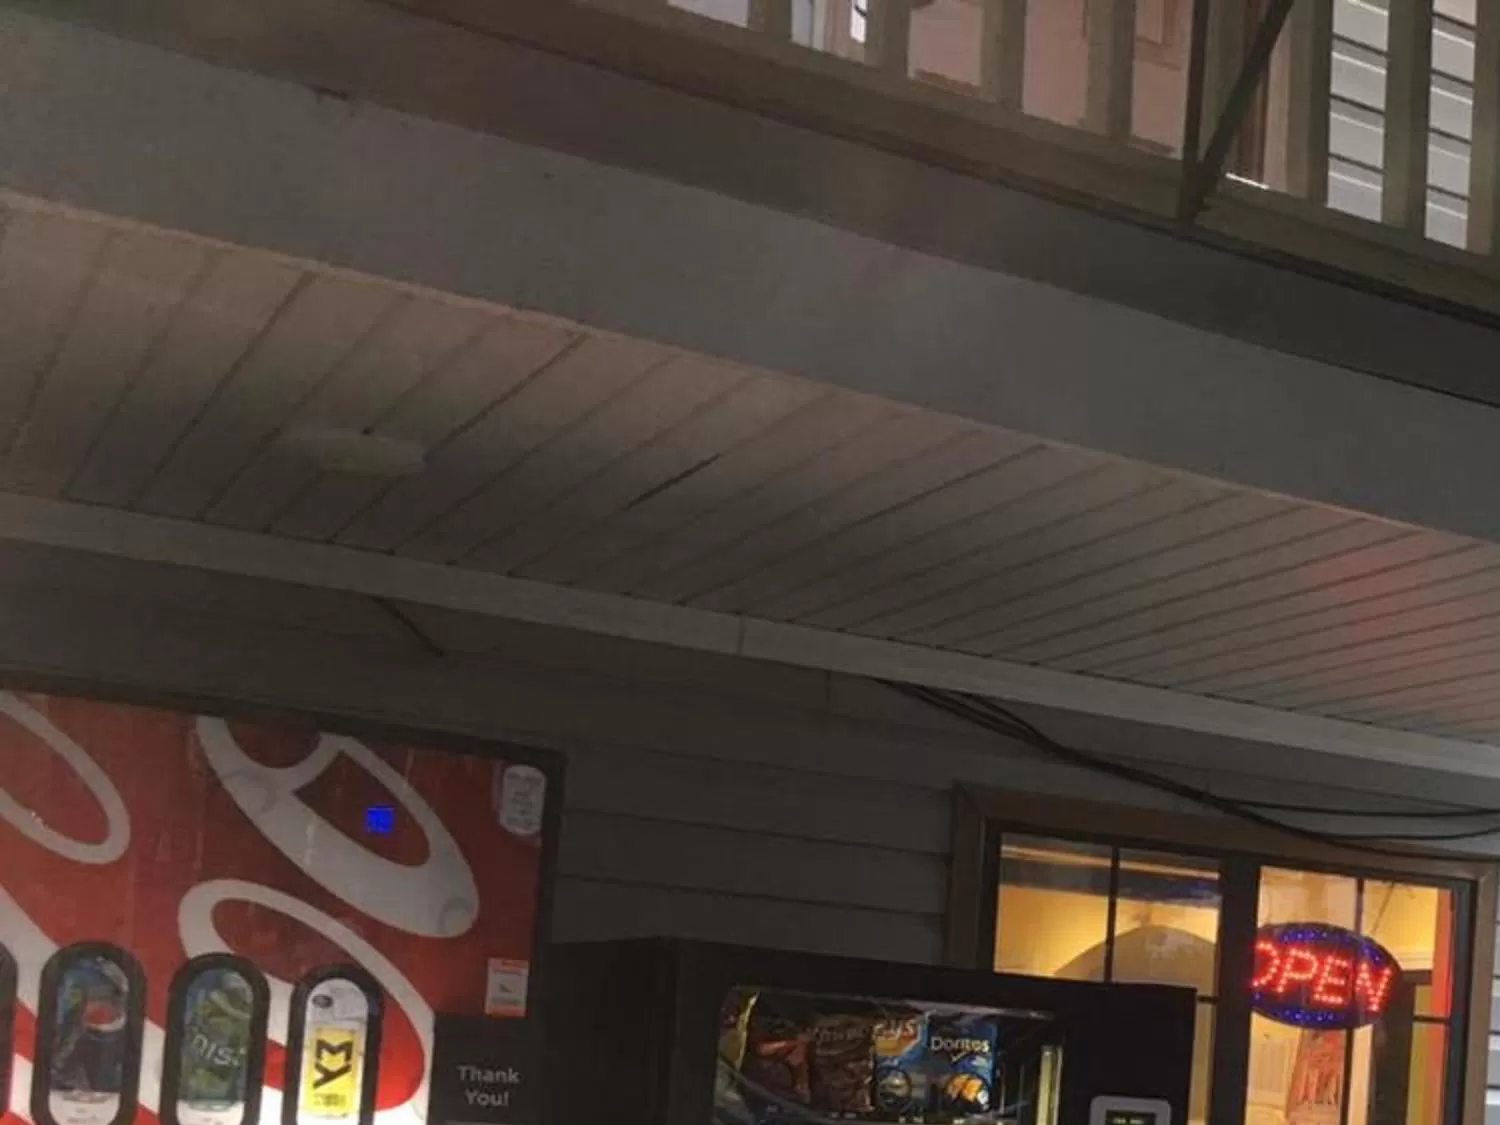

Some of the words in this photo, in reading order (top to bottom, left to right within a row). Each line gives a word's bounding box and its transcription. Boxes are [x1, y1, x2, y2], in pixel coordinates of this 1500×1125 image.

[1251, 940, 1394, 1013] OPEN
[930, 1035, 991, 1055] Doritos
[456, 1064, 521, 1085] Thank
[464, 1087, 510, 1107] You!
